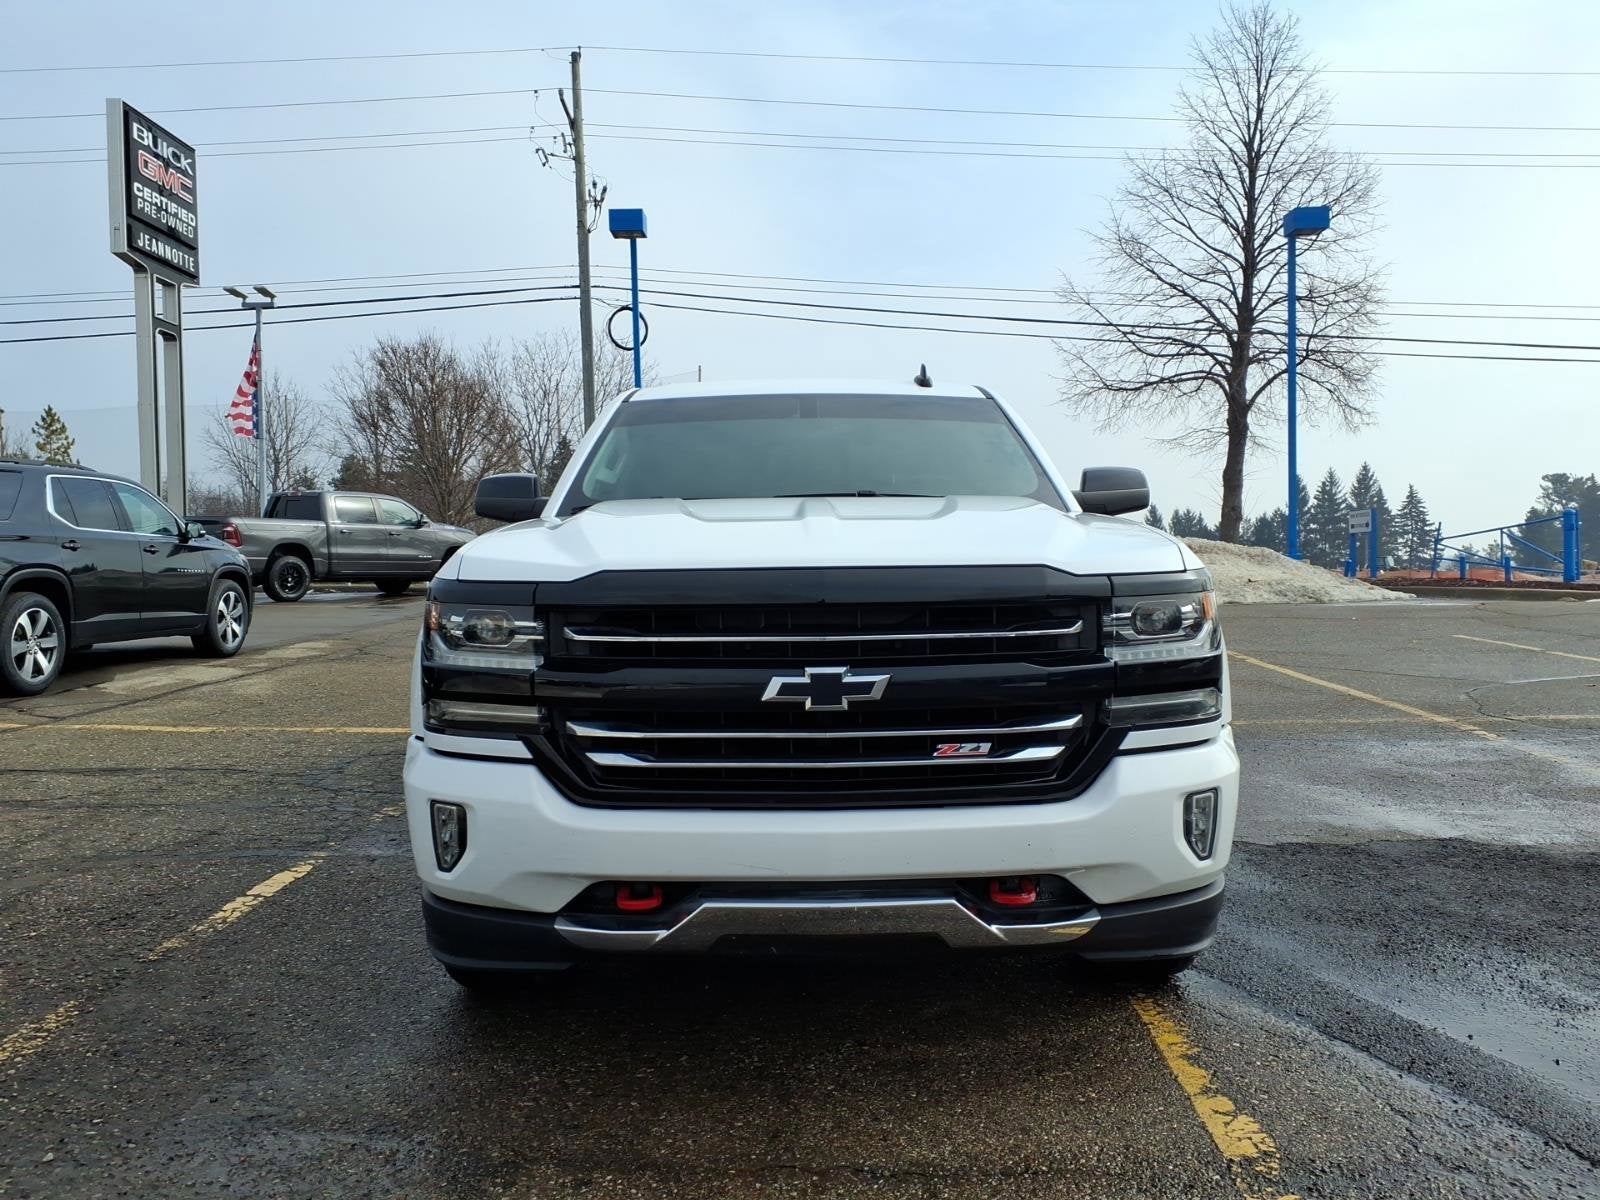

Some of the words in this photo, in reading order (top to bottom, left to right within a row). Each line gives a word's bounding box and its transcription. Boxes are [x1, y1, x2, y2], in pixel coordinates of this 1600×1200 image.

[133, 122, 194, 175] BUICK
[138, 150, 193, 204] GMC
[133, 181, 196, 227] CERTIFIED
[137, 199, 194, 238] PRE-OWNED
[138, 232, 195, 272] JEANNOTTE
[932, 742, 992, 757] Z71
